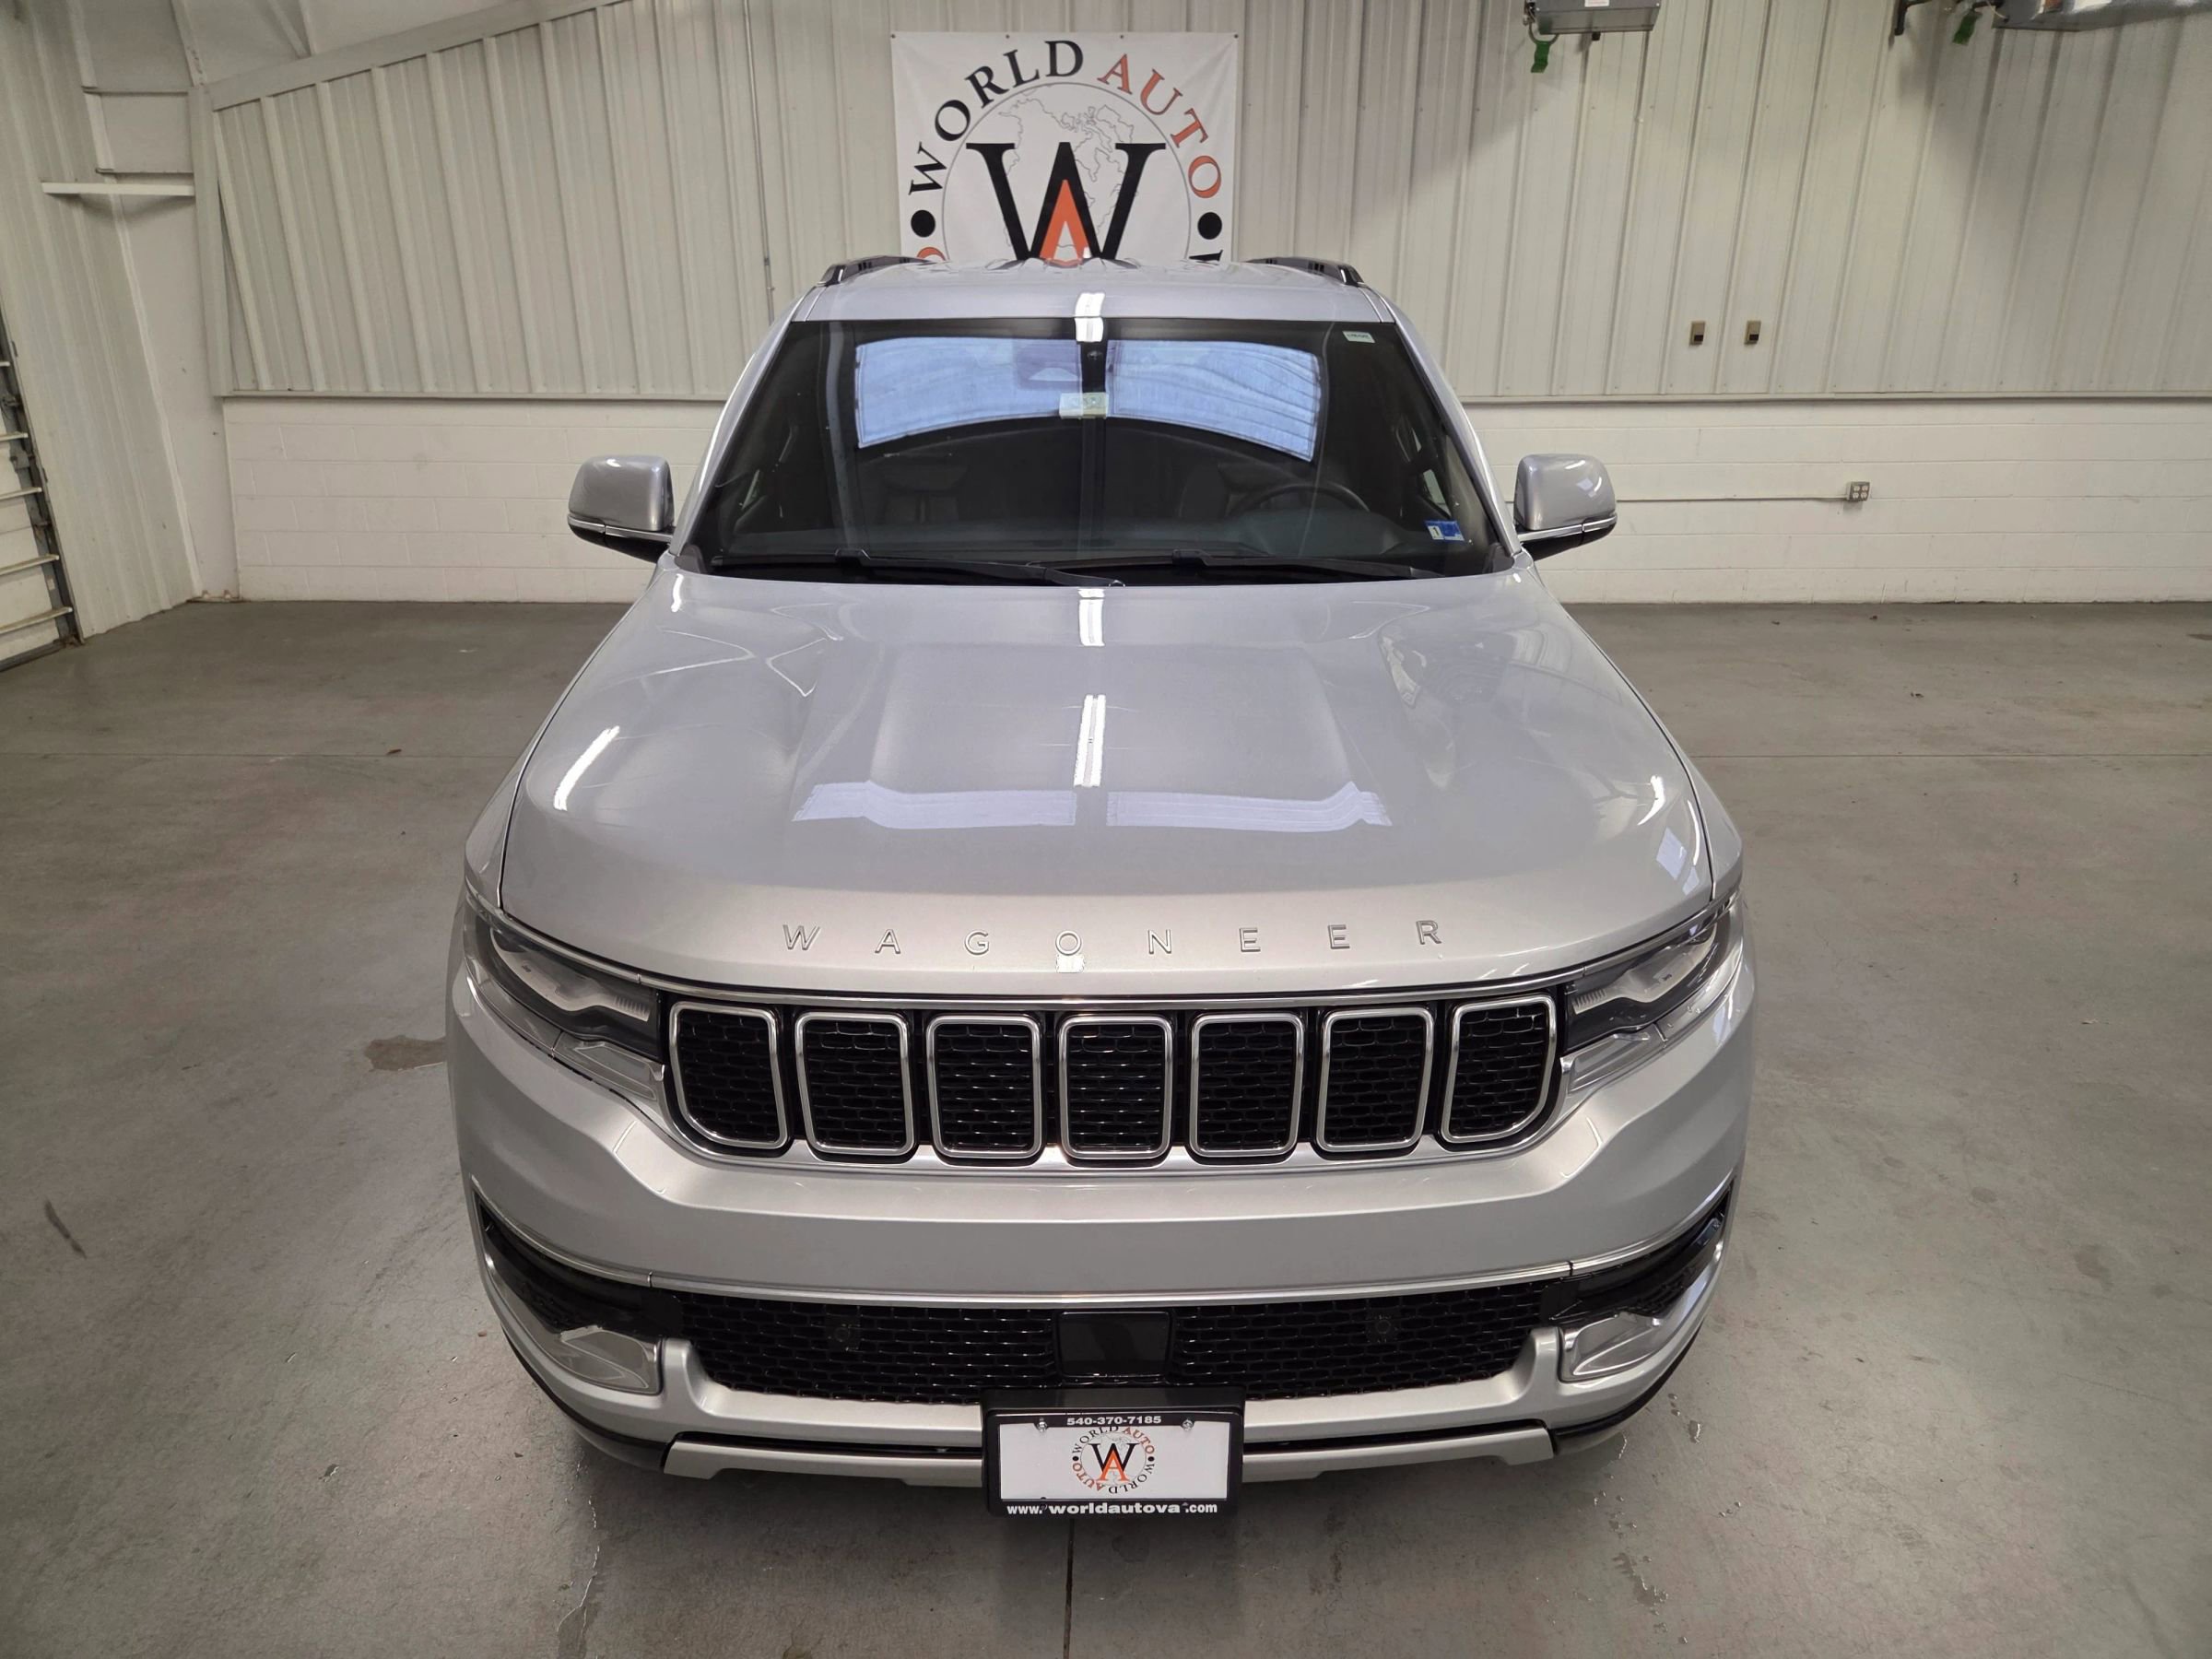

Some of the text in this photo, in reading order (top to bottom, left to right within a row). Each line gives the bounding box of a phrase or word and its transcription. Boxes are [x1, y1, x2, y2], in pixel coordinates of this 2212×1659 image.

[908, 40, 1222, 198] WORLD AUTO
[782, 920, 1442, 956] WAGONEER
[1066, 1416, 1161, 1426] 540-370-7185
[1072, 1426, 1155, 1454] WORLD AUTO
[1072, 1463, 1155, 1494] WORLD AUTO
